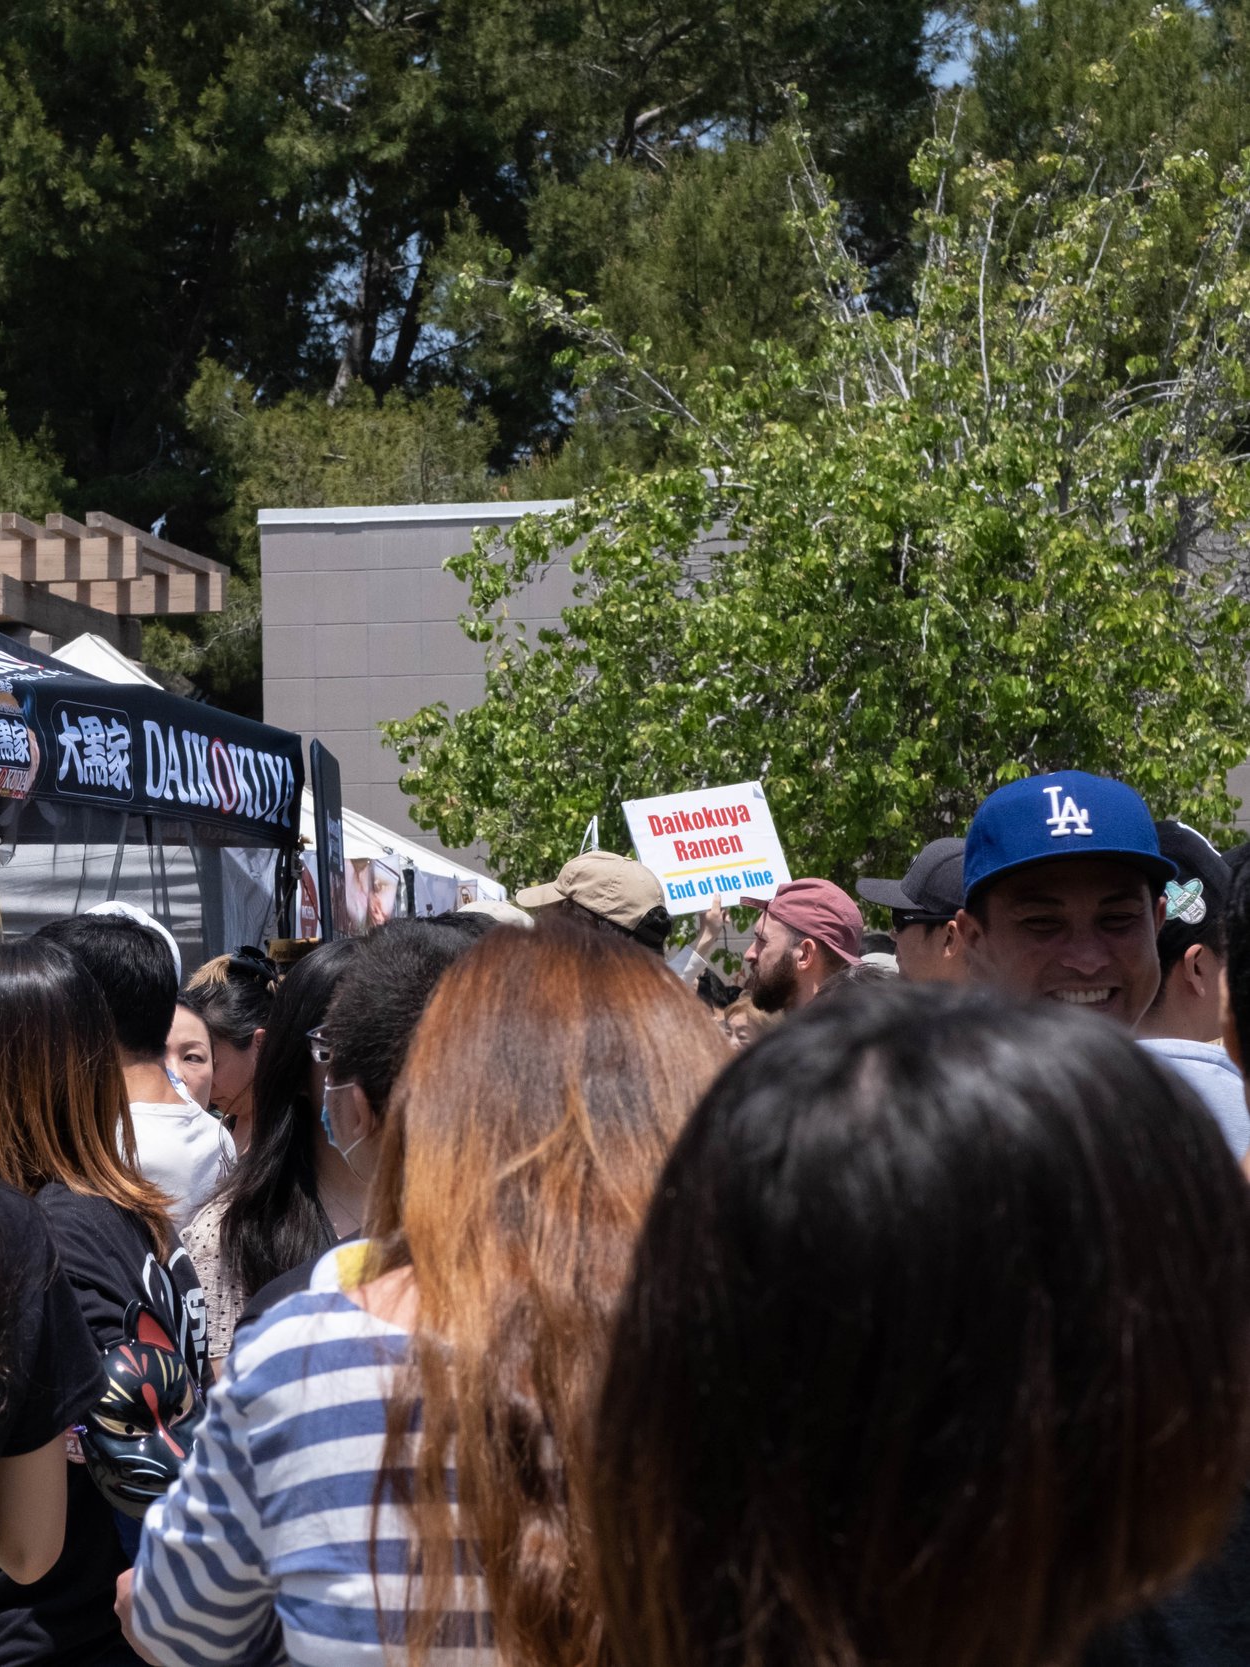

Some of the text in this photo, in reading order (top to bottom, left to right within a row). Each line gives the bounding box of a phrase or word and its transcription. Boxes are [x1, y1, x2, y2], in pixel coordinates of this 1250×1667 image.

[57, 710, 132, 791] 大黒家
[142, 719, 295, 829] DAIKOKUYA
[647, 804, 751, 837] Daikokuya
[1042, 786, 1094, 837] LA
[673, 834, 744, 862] Ramen
[666, 870, 774, 901] End of the line
